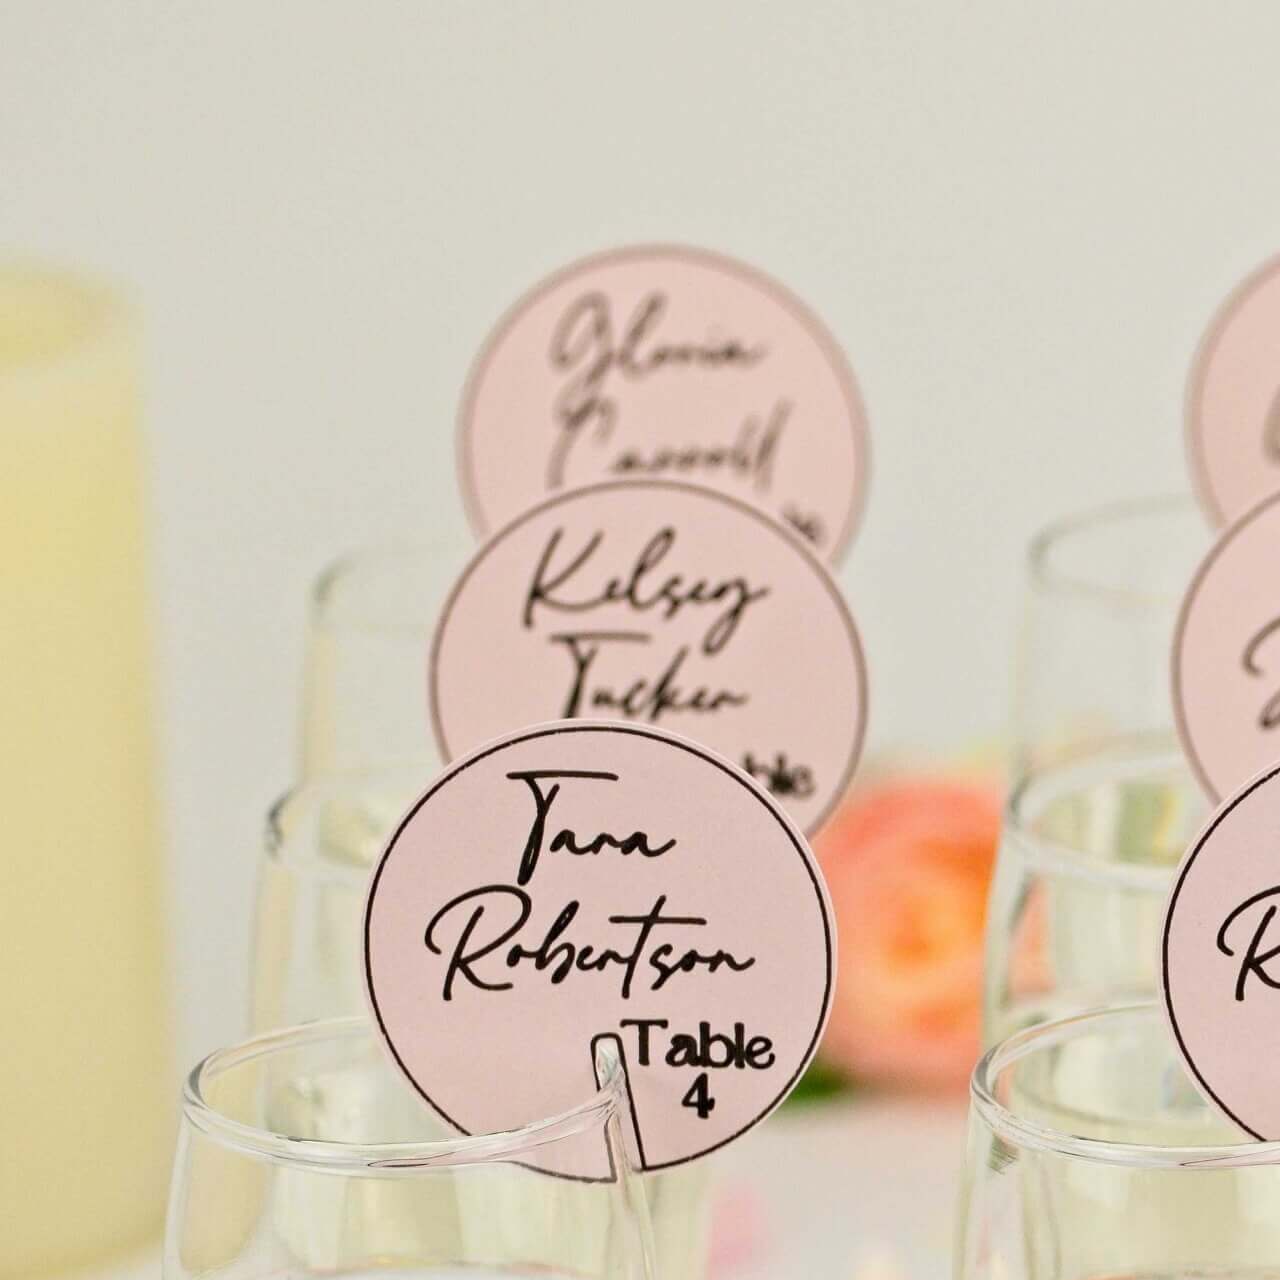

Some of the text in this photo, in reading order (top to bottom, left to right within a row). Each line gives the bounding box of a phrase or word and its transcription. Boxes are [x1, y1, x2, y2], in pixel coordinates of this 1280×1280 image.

[548, 289, 770, 425] Gloria
[522, 526, 772, 656] Kelsey
[548, 631, 750, 721] Tucker
[506, 770, 676, 886] Tara
[424, 884, 755, 1001] Robertson
[620, 1019, 776, 1069] Table
[681, 1073, 715, 1118] 4
